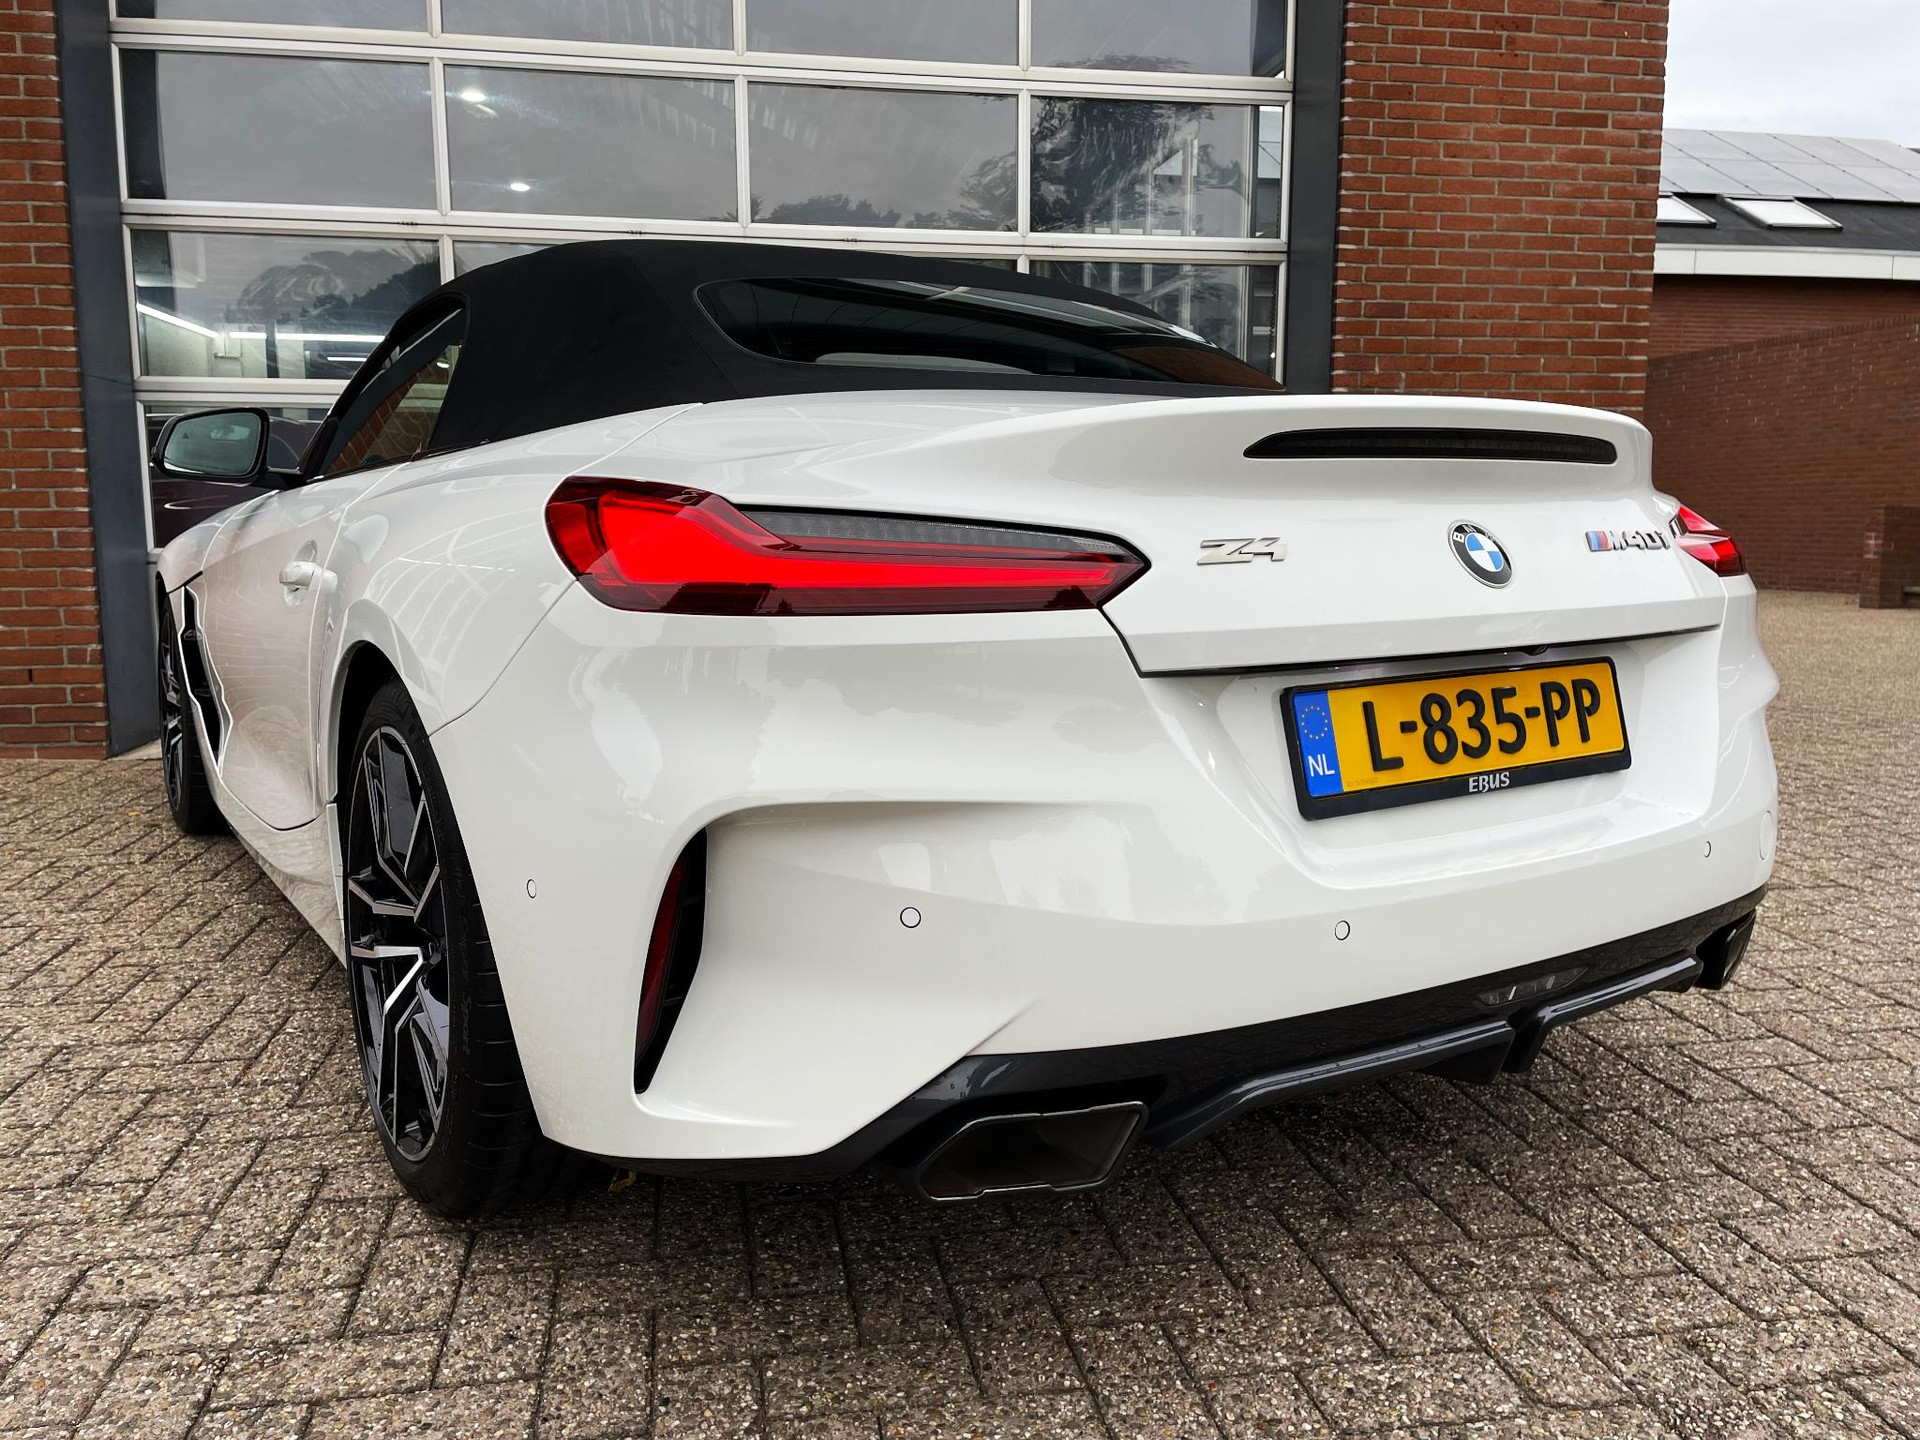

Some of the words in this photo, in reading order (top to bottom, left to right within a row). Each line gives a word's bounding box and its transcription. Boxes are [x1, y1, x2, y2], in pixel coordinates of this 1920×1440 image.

[1197, 537, 1287, 566] Z4
[1361, 678, 1601, 772] L-835-PP
[1308, 754, 1335, 777] NL
[1469, 771, 1510, 793] EBUS
